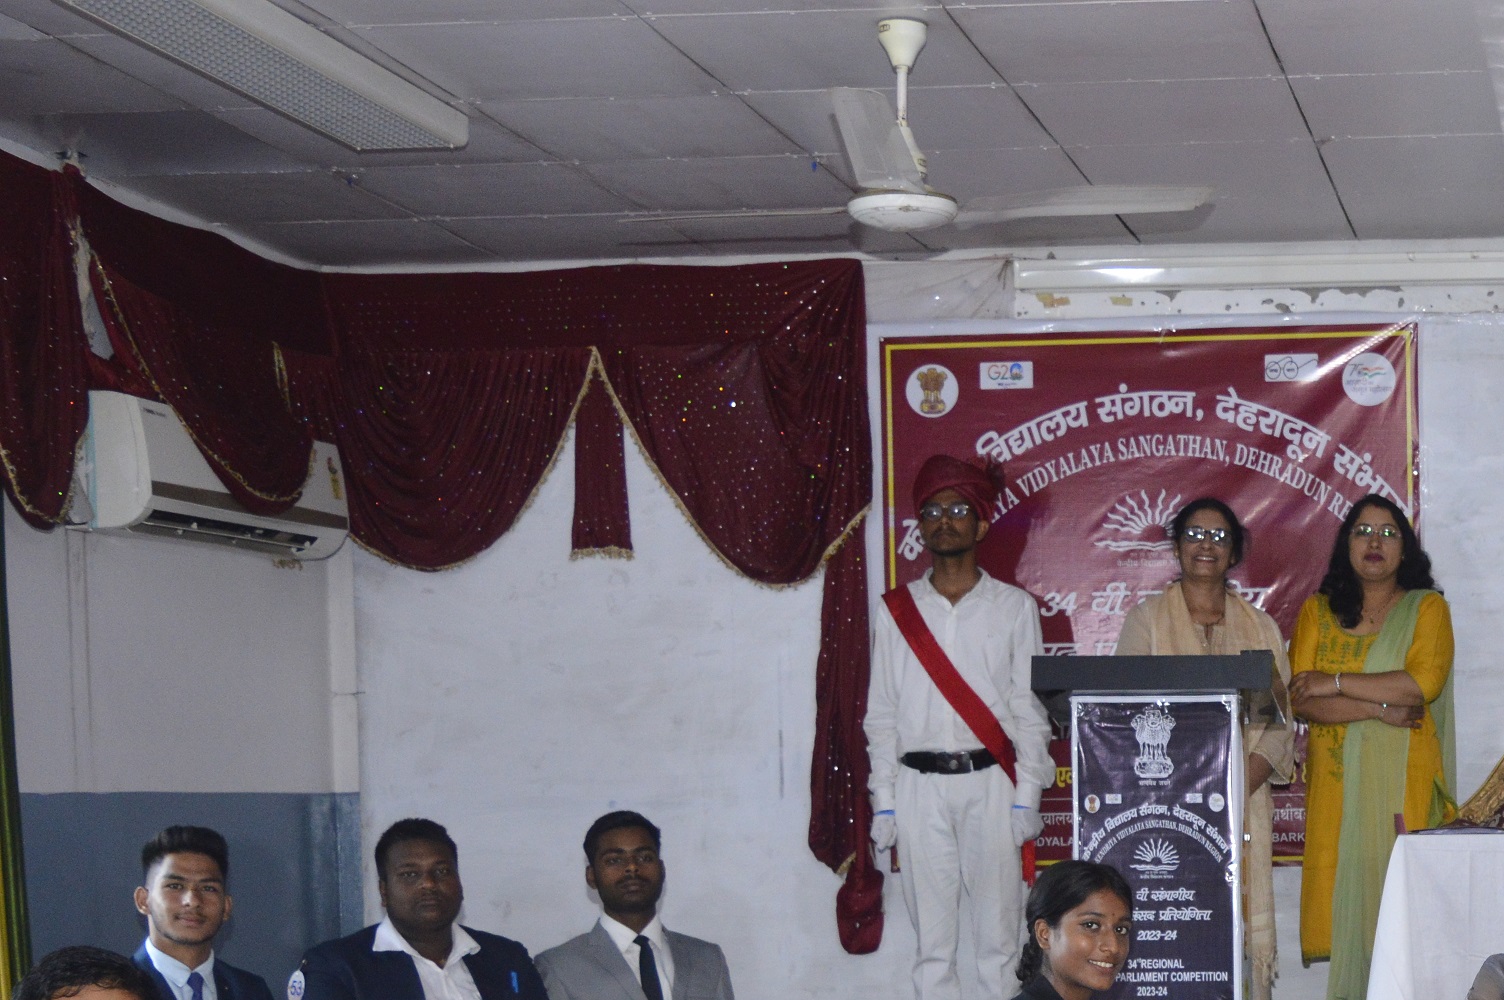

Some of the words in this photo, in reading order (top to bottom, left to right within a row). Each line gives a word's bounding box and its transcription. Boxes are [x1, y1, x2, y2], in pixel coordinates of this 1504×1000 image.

[1216, 386, 1331, 462] देहरादून
[1016, 442, 1114, 497] VIDYALAYA
[1118, 434, 1231, 466] SANGATHAN,
[1234, 444, 1332, 505] DEHRADUN
[1040, 591, 1078, 617] 34
[1035, 836, 1073, 847] DYALA
[1137, 929, 1177, 941] 2023-24
[1170, 971, 1228, 982] COMPETITION
[1137, 986, 1168, 997] 2023-24
